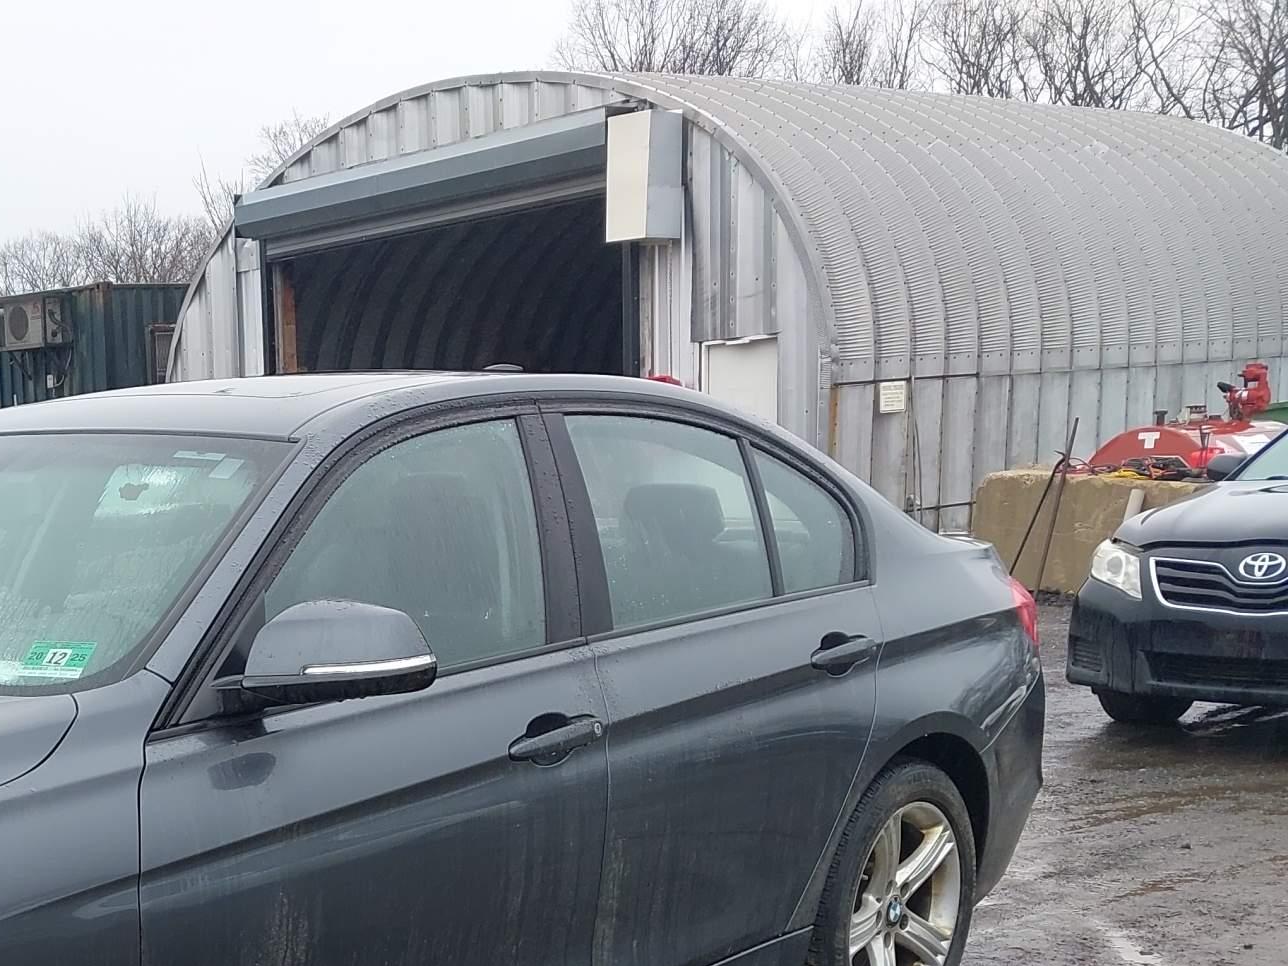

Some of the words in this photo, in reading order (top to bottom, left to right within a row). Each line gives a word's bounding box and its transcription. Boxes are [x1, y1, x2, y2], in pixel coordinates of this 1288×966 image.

[27, 651, 44, 661] 20
[45, 650, 68, 665] 12
[70, 653, 88, 662] 25
